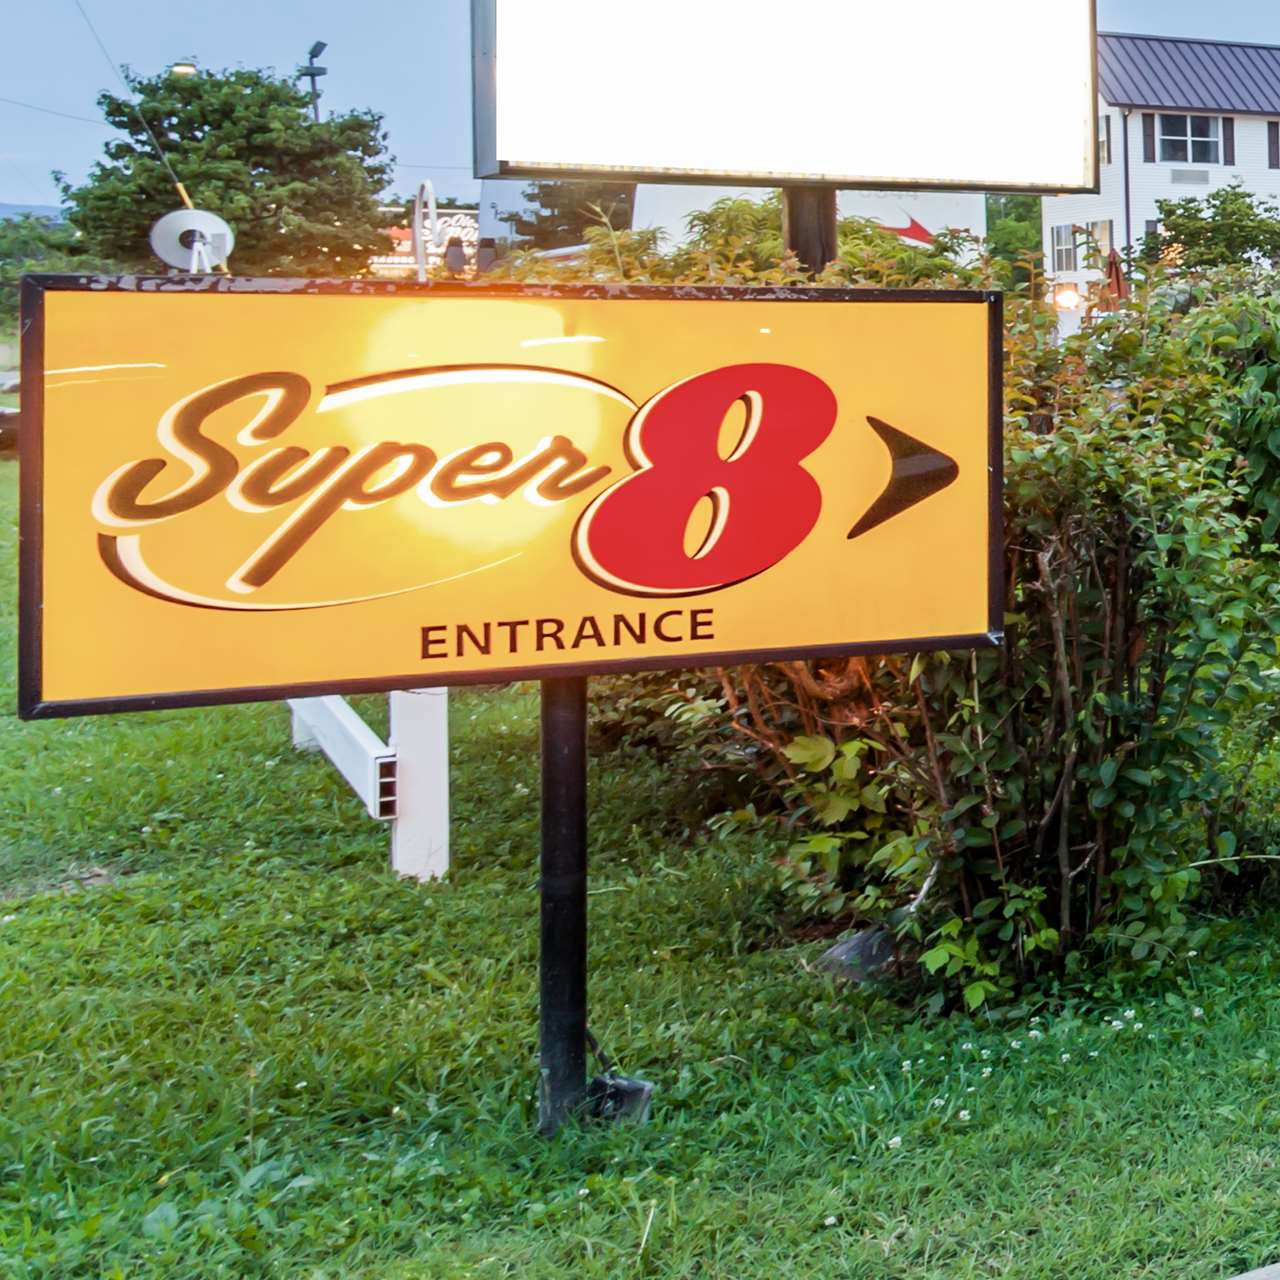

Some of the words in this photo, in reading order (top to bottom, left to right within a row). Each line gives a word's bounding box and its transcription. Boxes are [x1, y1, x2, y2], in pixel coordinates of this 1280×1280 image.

[91, 370, 612, 594] Super
[570, 362, 838, 599] 8
[420, 608, 715, 660] ENTRANCE
